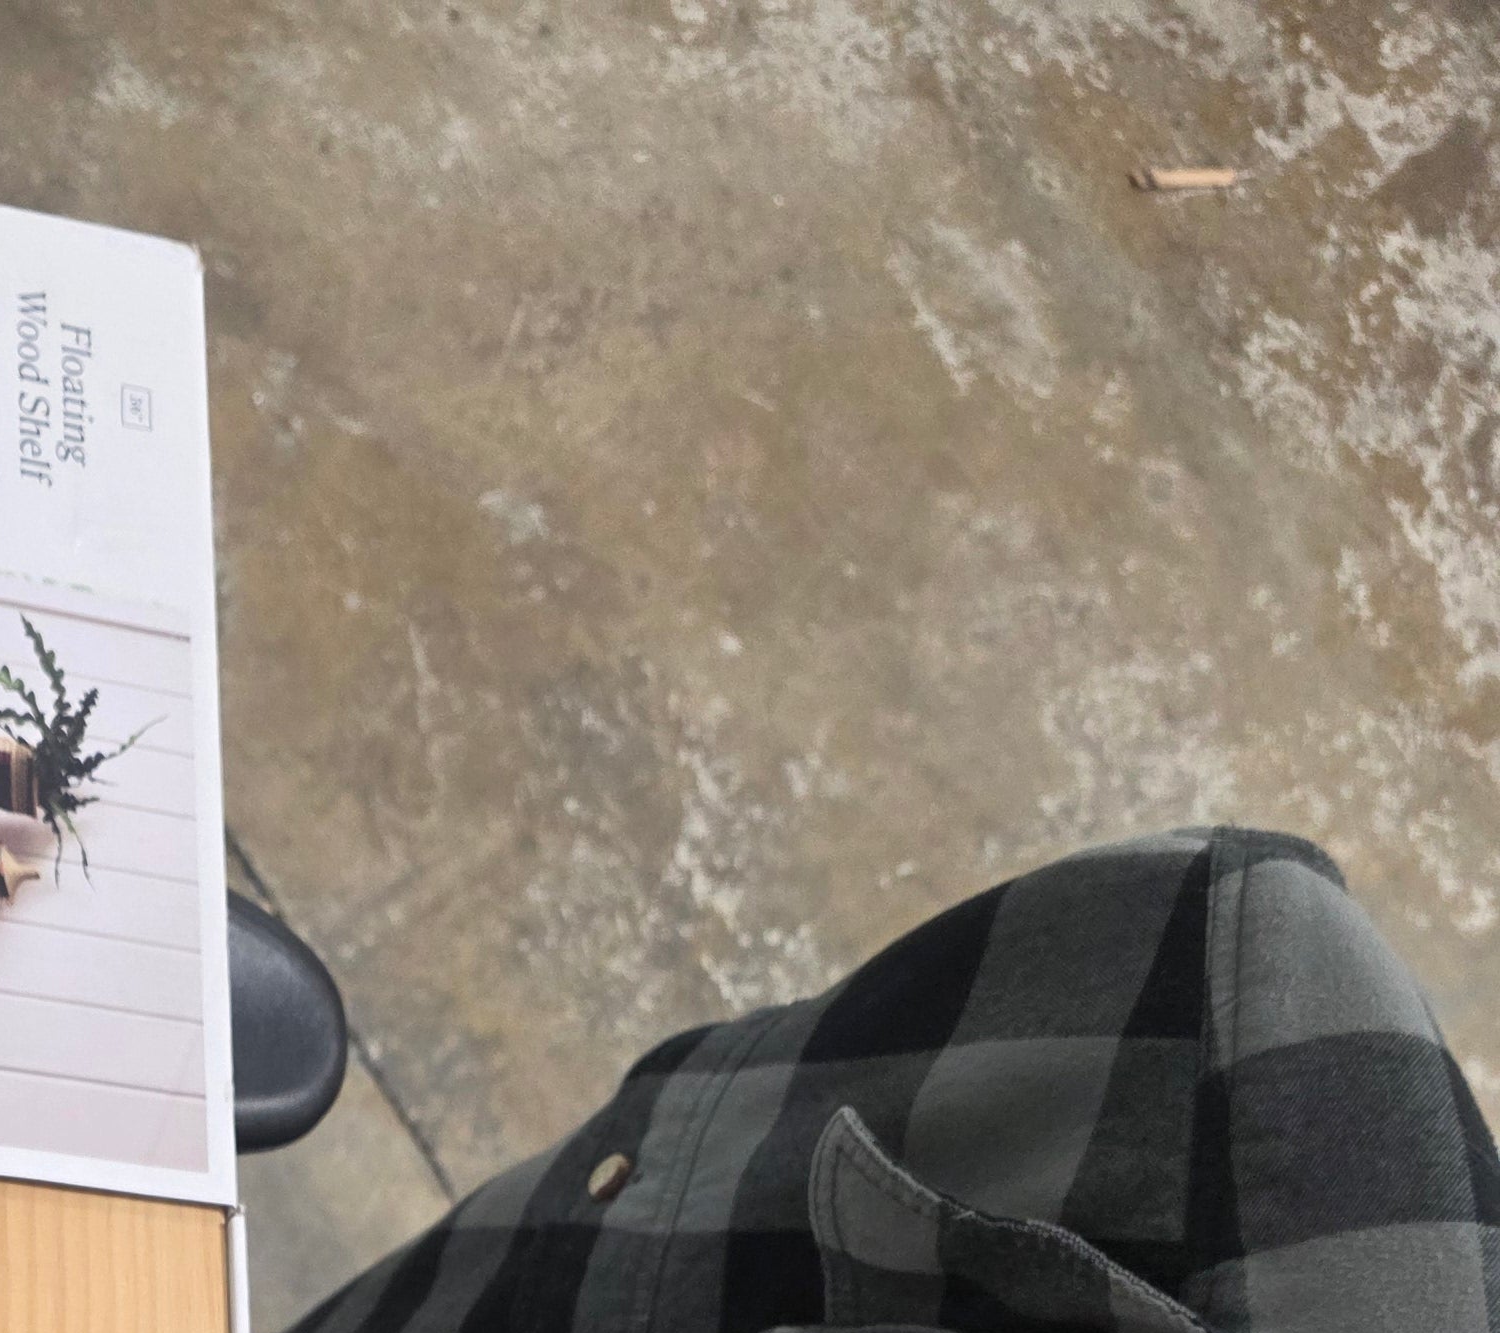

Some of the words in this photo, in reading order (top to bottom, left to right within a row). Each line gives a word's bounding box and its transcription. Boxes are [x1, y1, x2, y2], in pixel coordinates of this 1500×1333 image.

[16, 291, 49, 386] Wood
[18, 390, 52, 488] Shelf
[55, 321, 95, 468] Floating
